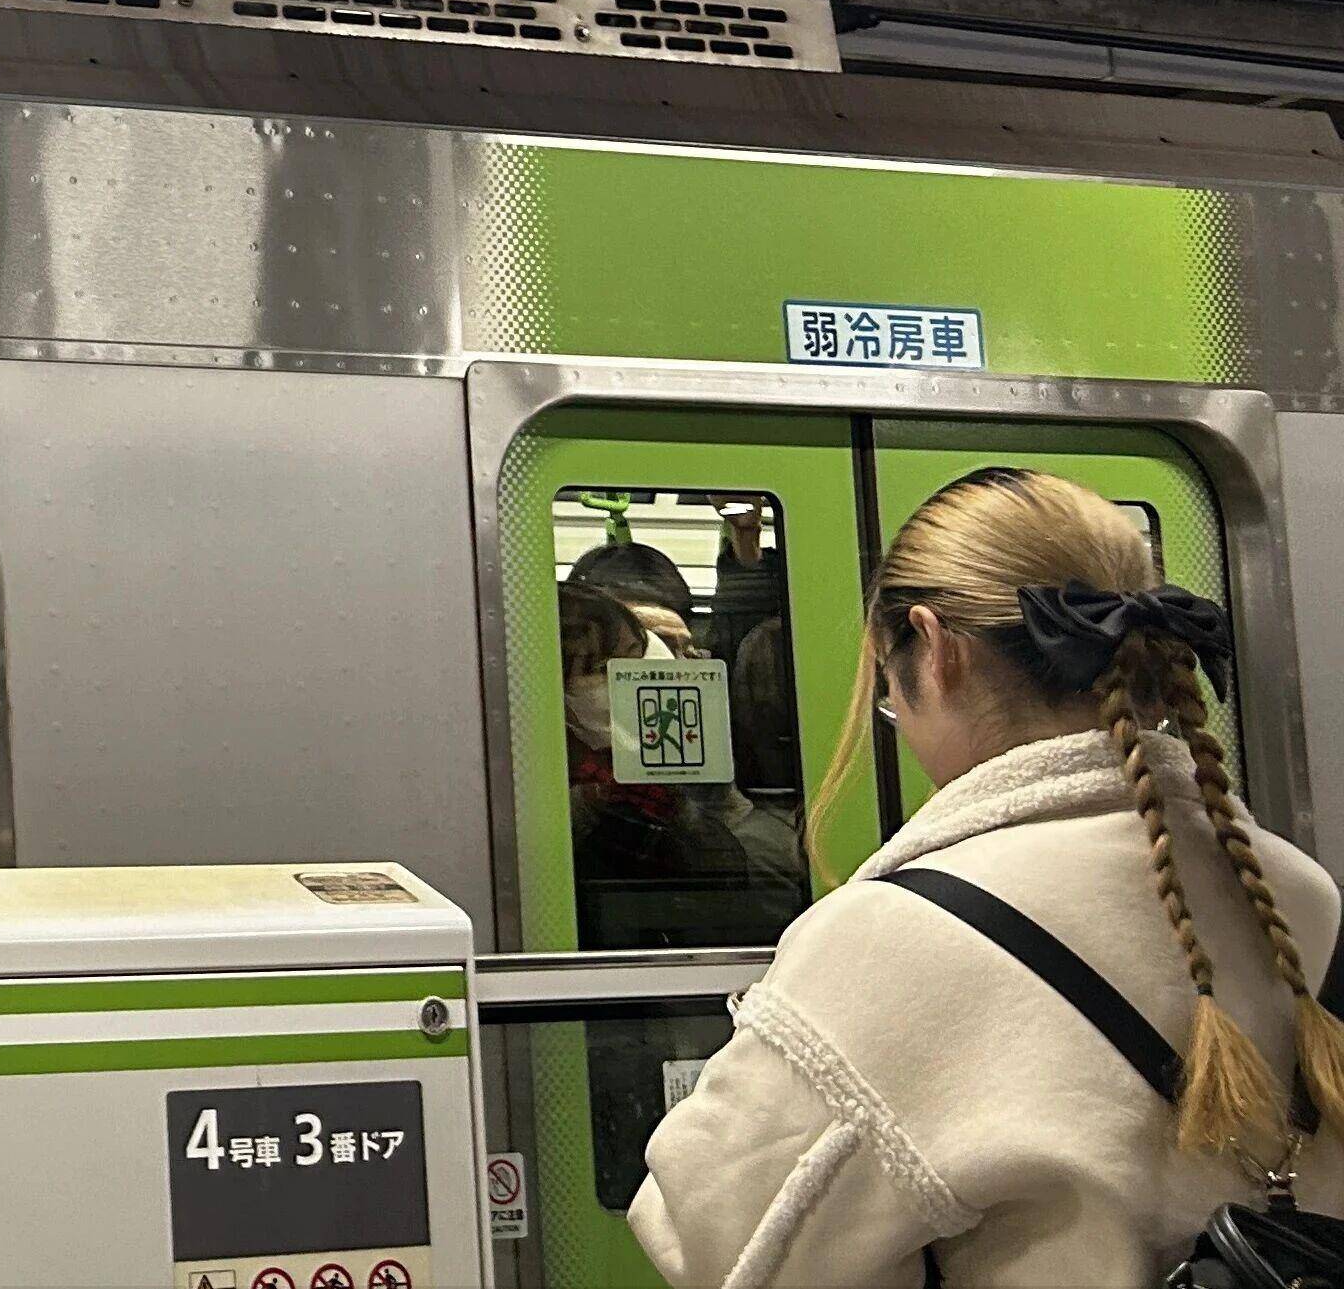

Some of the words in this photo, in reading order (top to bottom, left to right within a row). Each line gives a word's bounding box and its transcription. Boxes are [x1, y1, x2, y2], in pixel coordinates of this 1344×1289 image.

[801, 310, 968, 363] 弱冷房車
[185, 1108, 282, 1170] 4号車
[294, 1112, 405, 1166] 3番ドア
